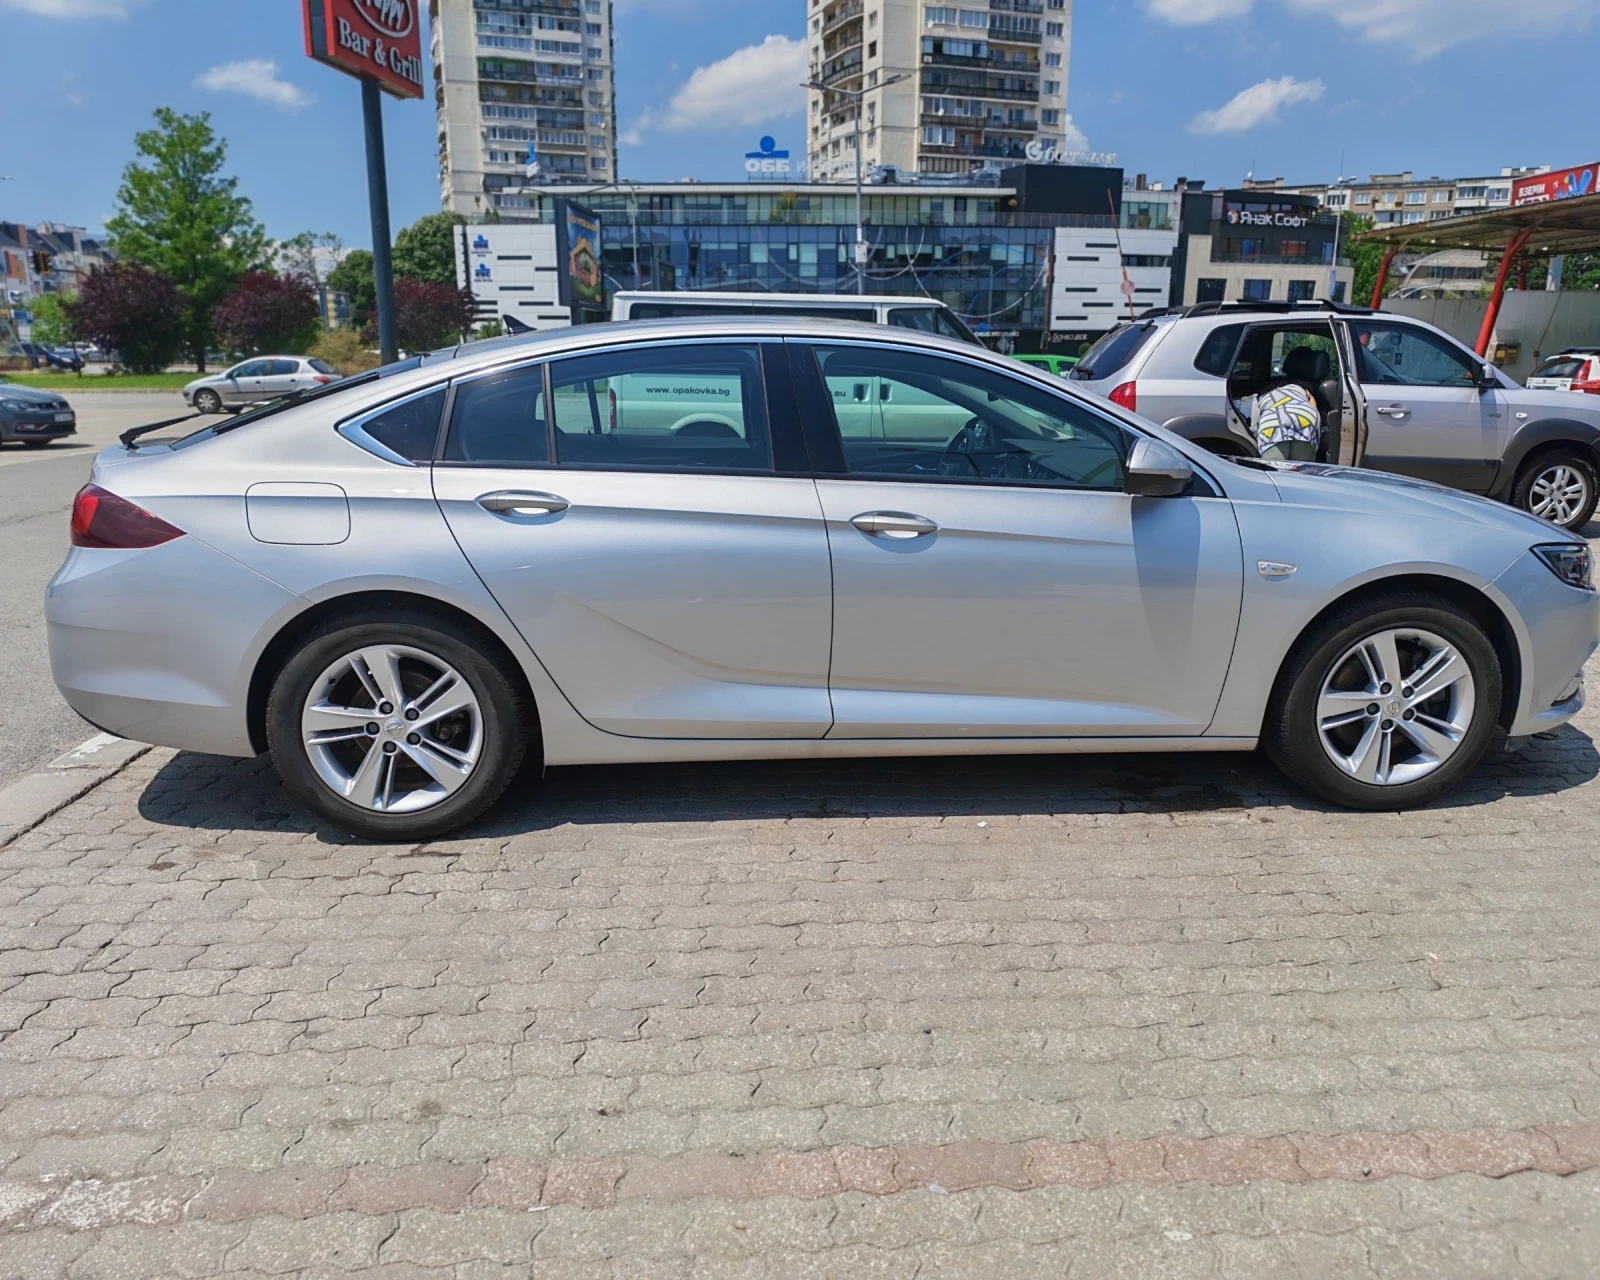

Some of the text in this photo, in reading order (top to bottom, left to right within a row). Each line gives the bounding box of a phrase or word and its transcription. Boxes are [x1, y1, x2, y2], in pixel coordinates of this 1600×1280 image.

[338, 17, 423, 86] Bar & Grill
[745, 160, 790, 173] ОББ
[1518, 183, 1546, 197] ВЗЕМИ
[1240, 211, 1308, 227] Янак Софт
